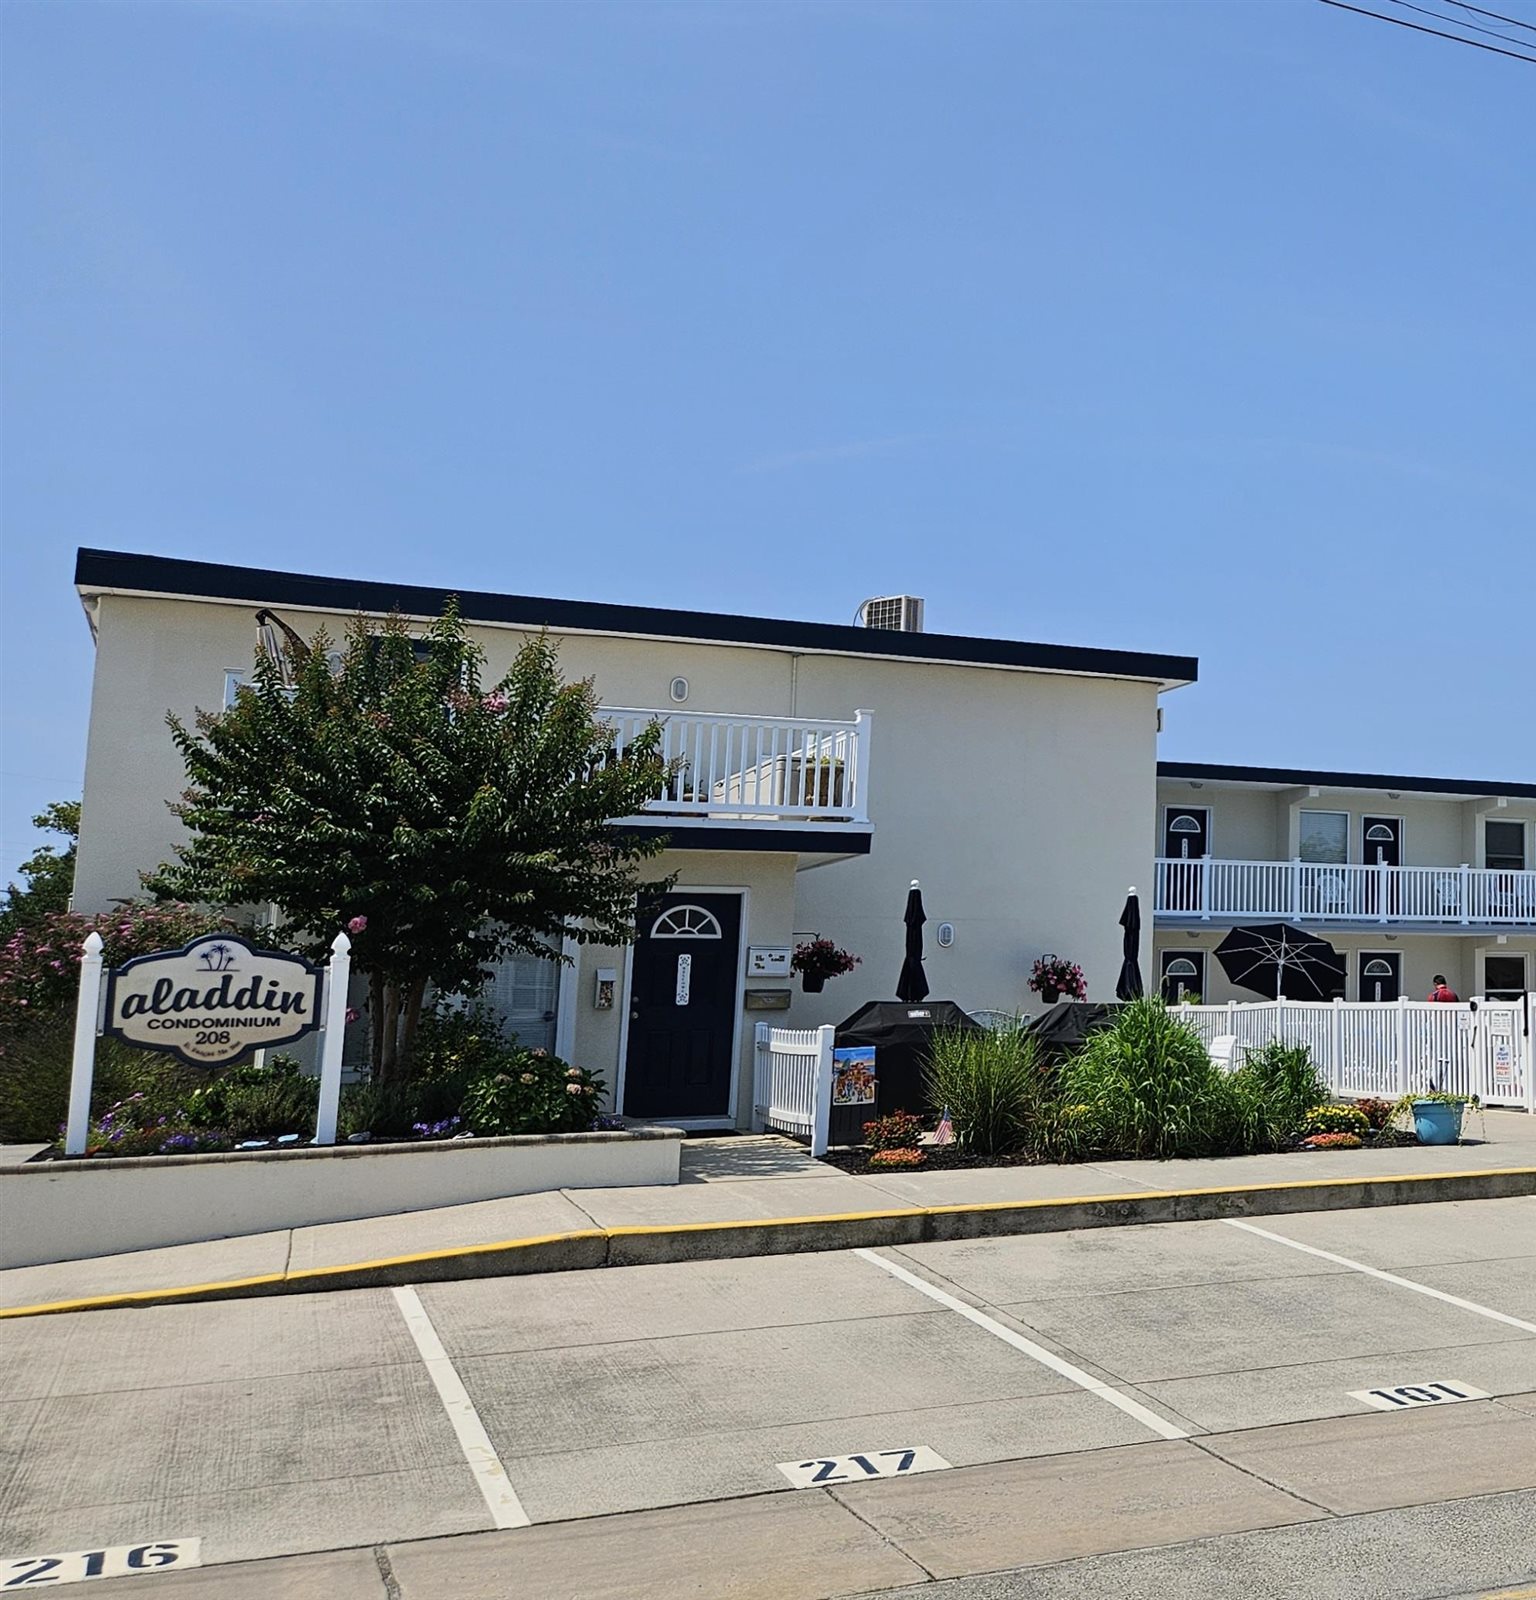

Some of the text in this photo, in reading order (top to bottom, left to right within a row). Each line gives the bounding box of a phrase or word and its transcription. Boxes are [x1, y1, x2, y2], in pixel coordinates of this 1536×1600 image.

[121, 974, 307, 1020] aladdin
[146, 1016, 281, 1030] CONDOMINIUM
[195, 1030, 231, 1045] 208
[1369, 1383, 1469, 1405] 101
[799, 1449, 916, 1482] 217
[4, 1543, 180, 1586] 216
